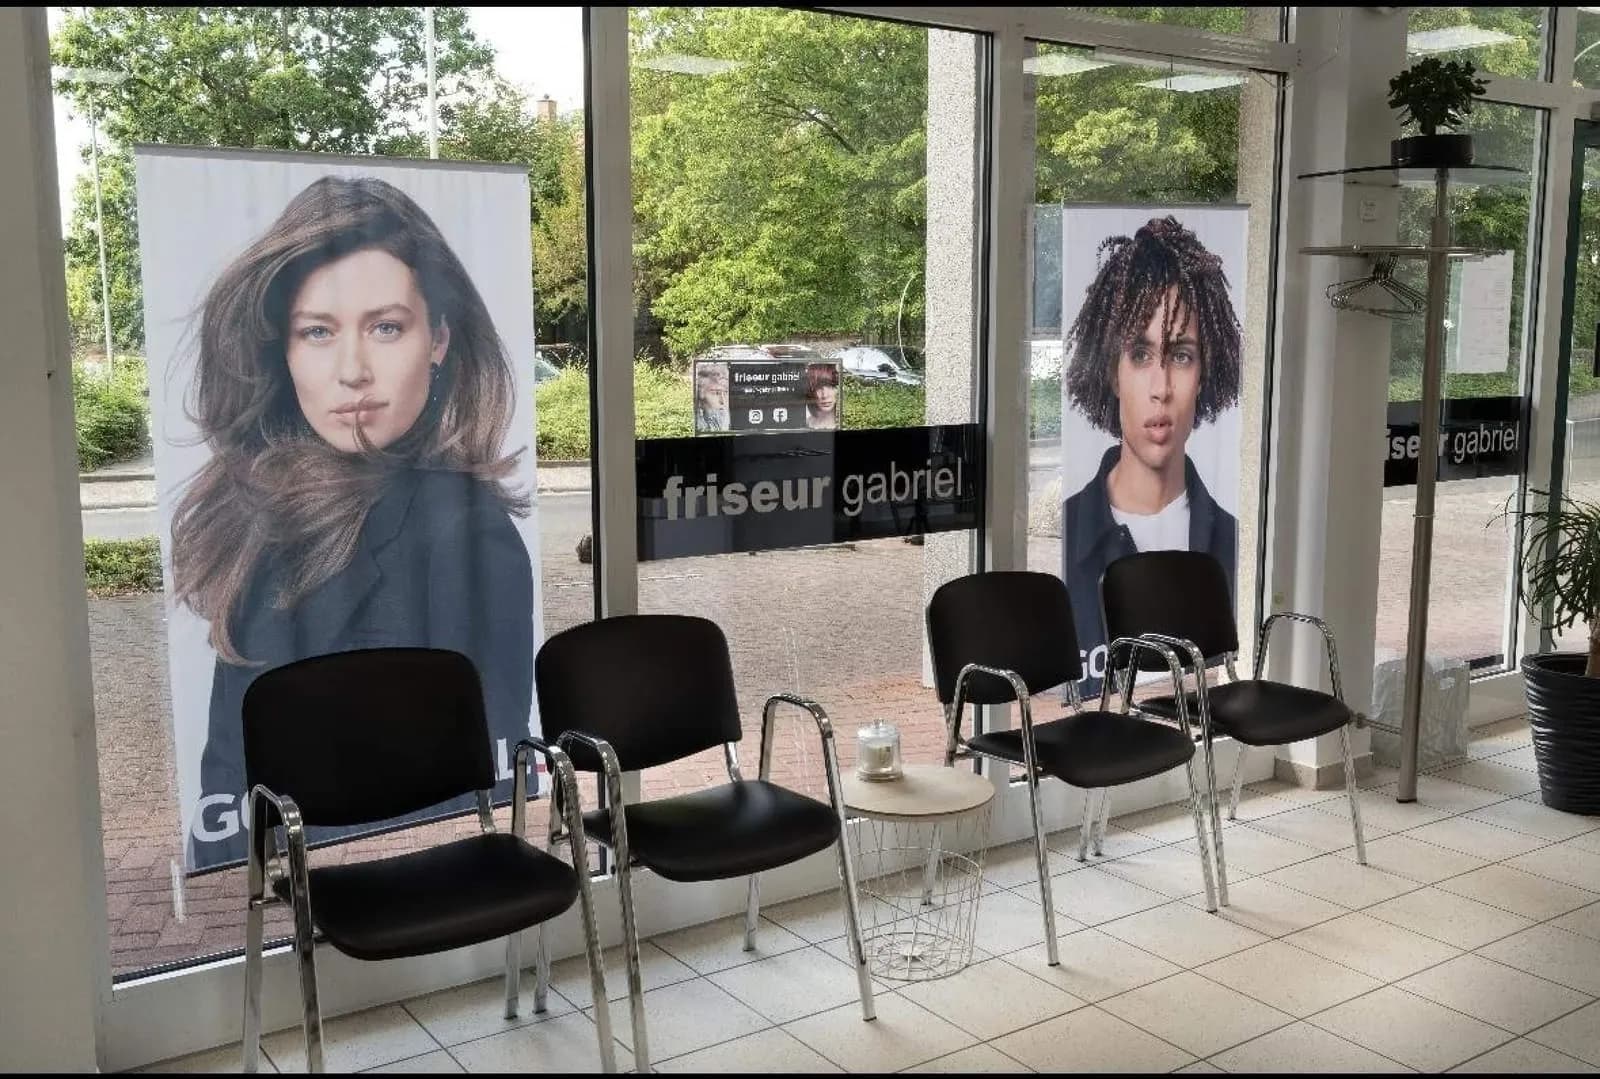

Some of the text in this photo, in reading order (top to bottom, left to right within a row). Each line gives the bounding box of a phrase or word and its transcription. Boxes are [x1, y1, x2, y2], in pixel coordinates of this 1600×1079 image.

[1385, 420, 1520, 464] iser gabriel
[663, 457, 962, 521] friseur gabriel
